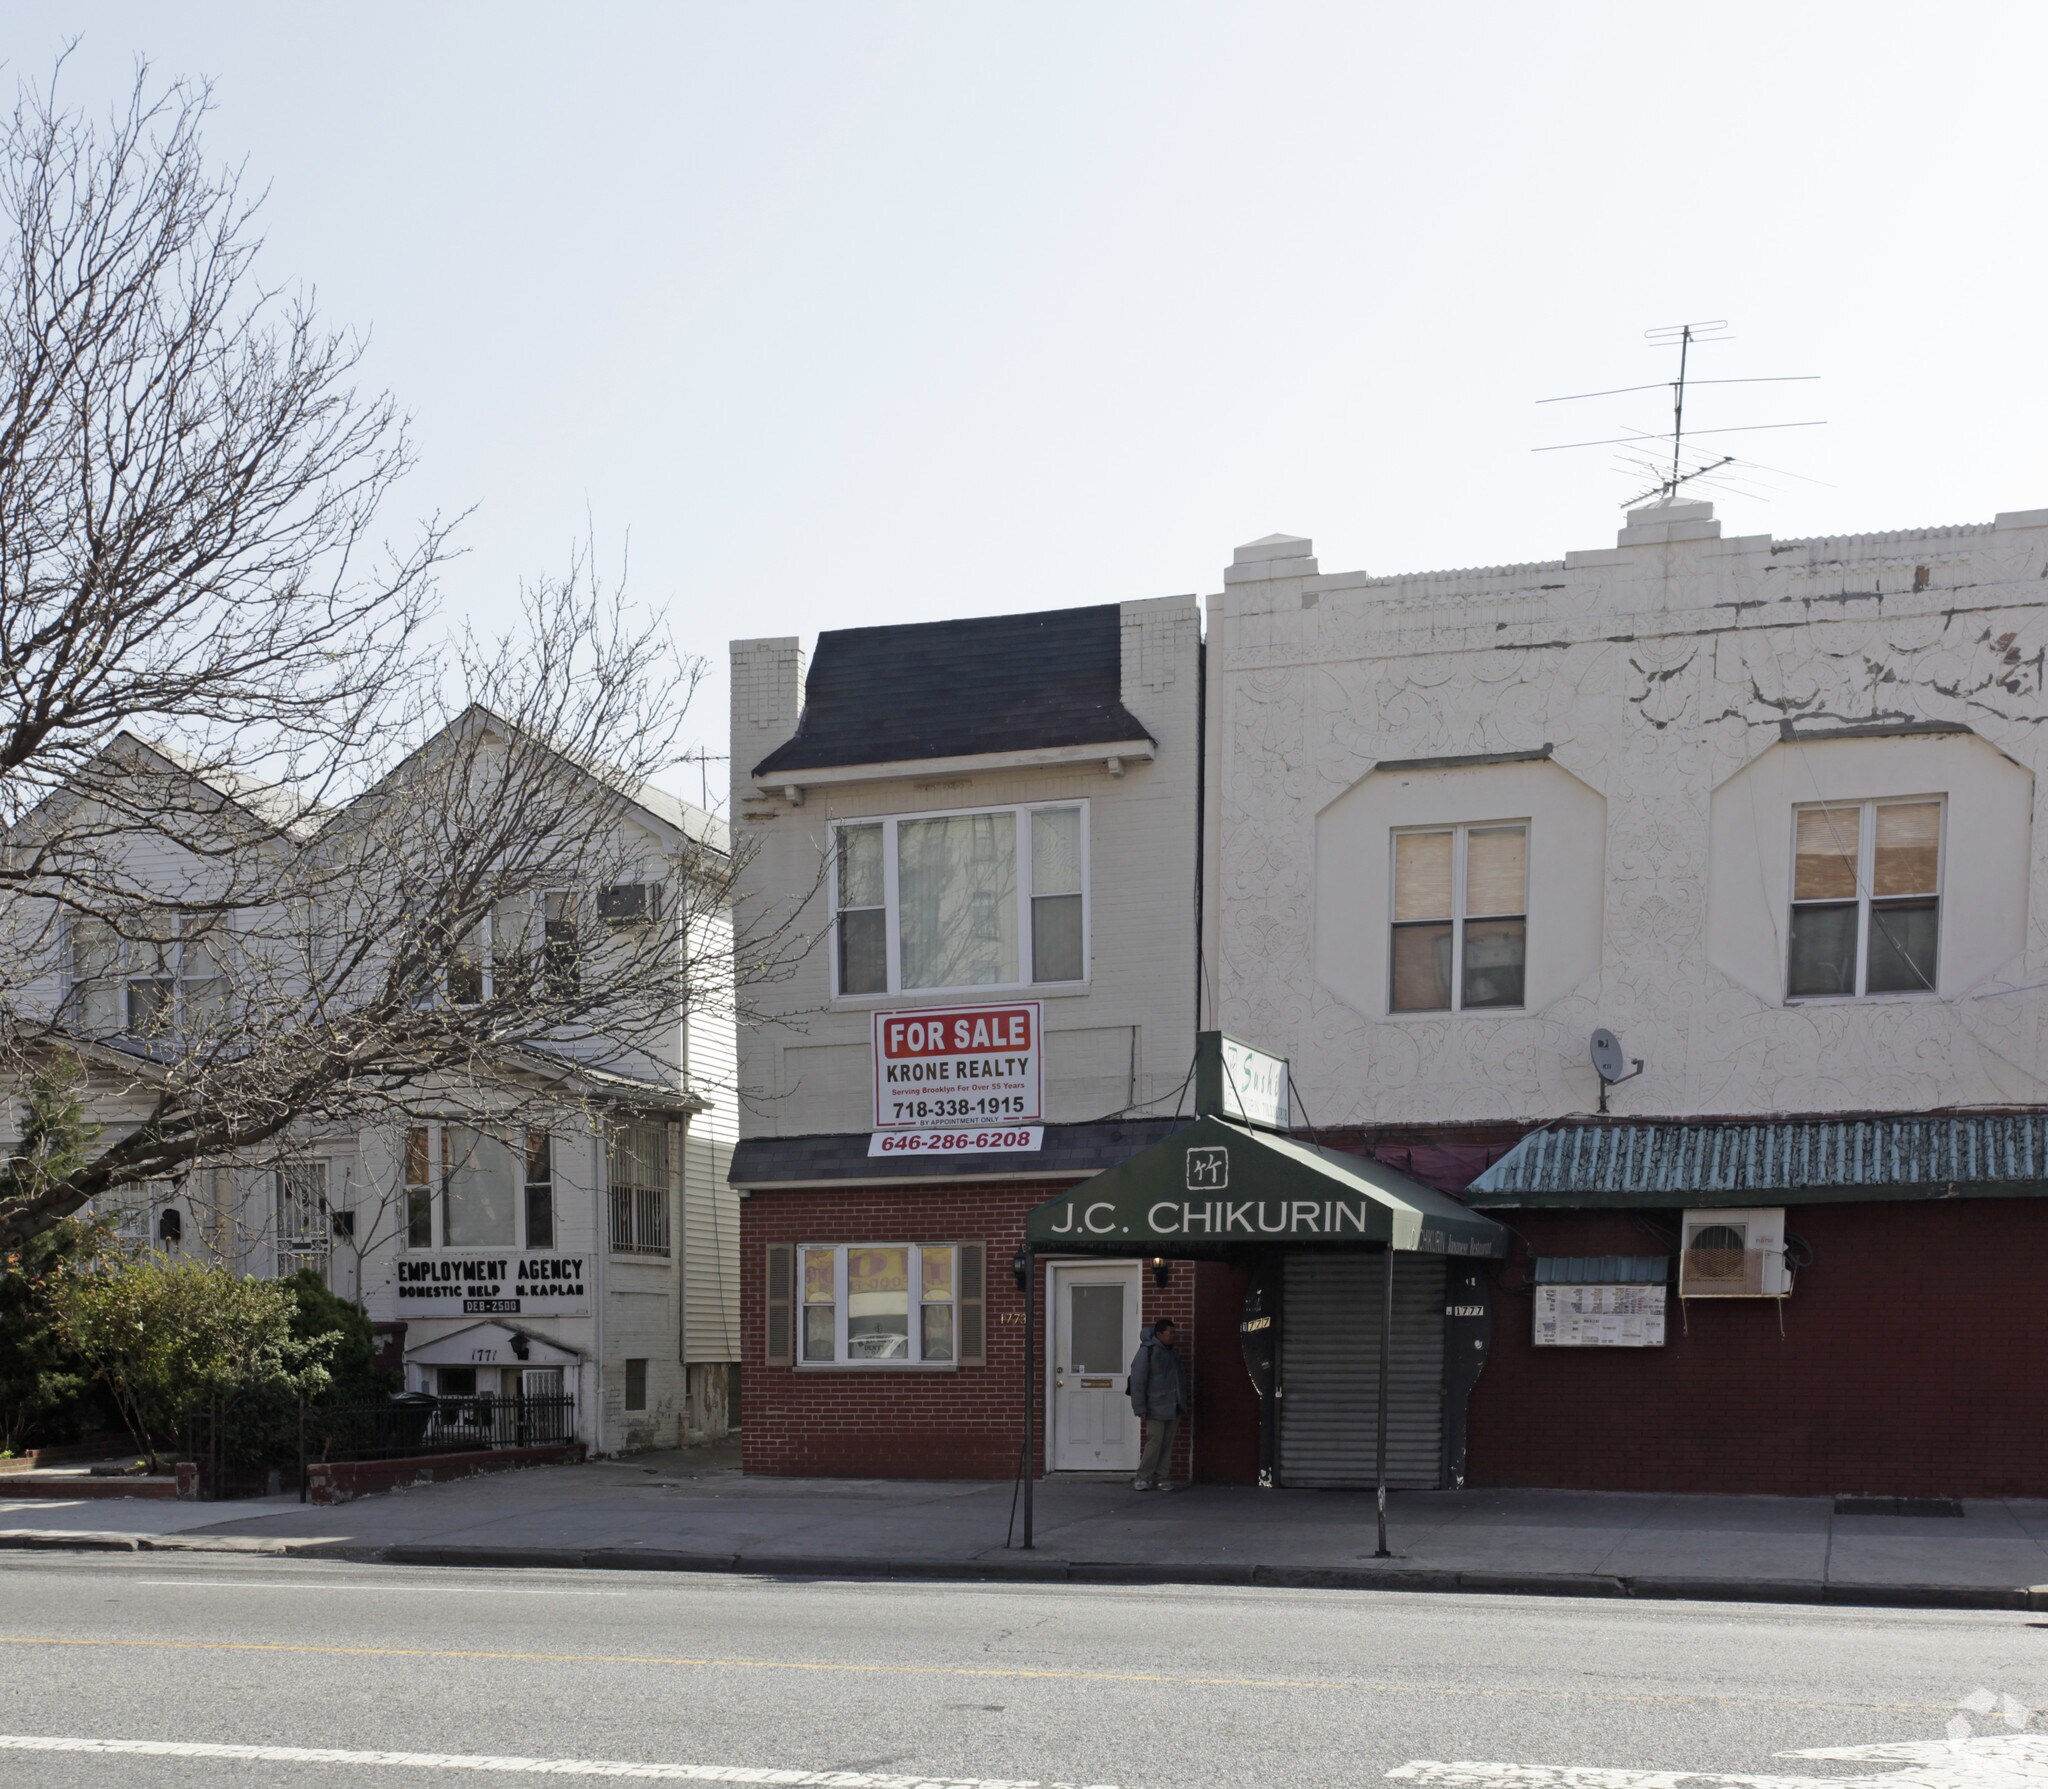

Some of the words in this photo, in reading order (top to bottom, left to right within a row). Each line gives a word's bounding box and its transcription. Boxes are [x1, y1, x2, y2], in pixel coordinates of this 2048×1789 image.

[891, 1021, 945, 1053] FOR
[954, 1016, 1026, 1049] SALE
[887, 1062, 949, 1083] KRONE
[957, 1058, 1029, 1079] REALTY
[1241, 1053, 1280, 1097] Sushi
[922, 1086, 955, 1094] Brooklyn
[893, 1096, 1024, 1119] 718-338-1915
[881, 1131, 1030, 1151] 646-286-6208
[1051, 1202, 1129, 1234] J.C.
[1147, 1201, 1367, 1233] CHIKURIN
[398, 1260, 507, 1281] EMPLOYMENT
[518, 1259, 583, 1280] AGENCY
[399, 1285, 462, 1298] DOMESTIC
[1001, 1313, 1026, 1325] 1773
[1457, 1306, 1482, 1316] 1777
[472, 1349, 497, 1362] 1771
